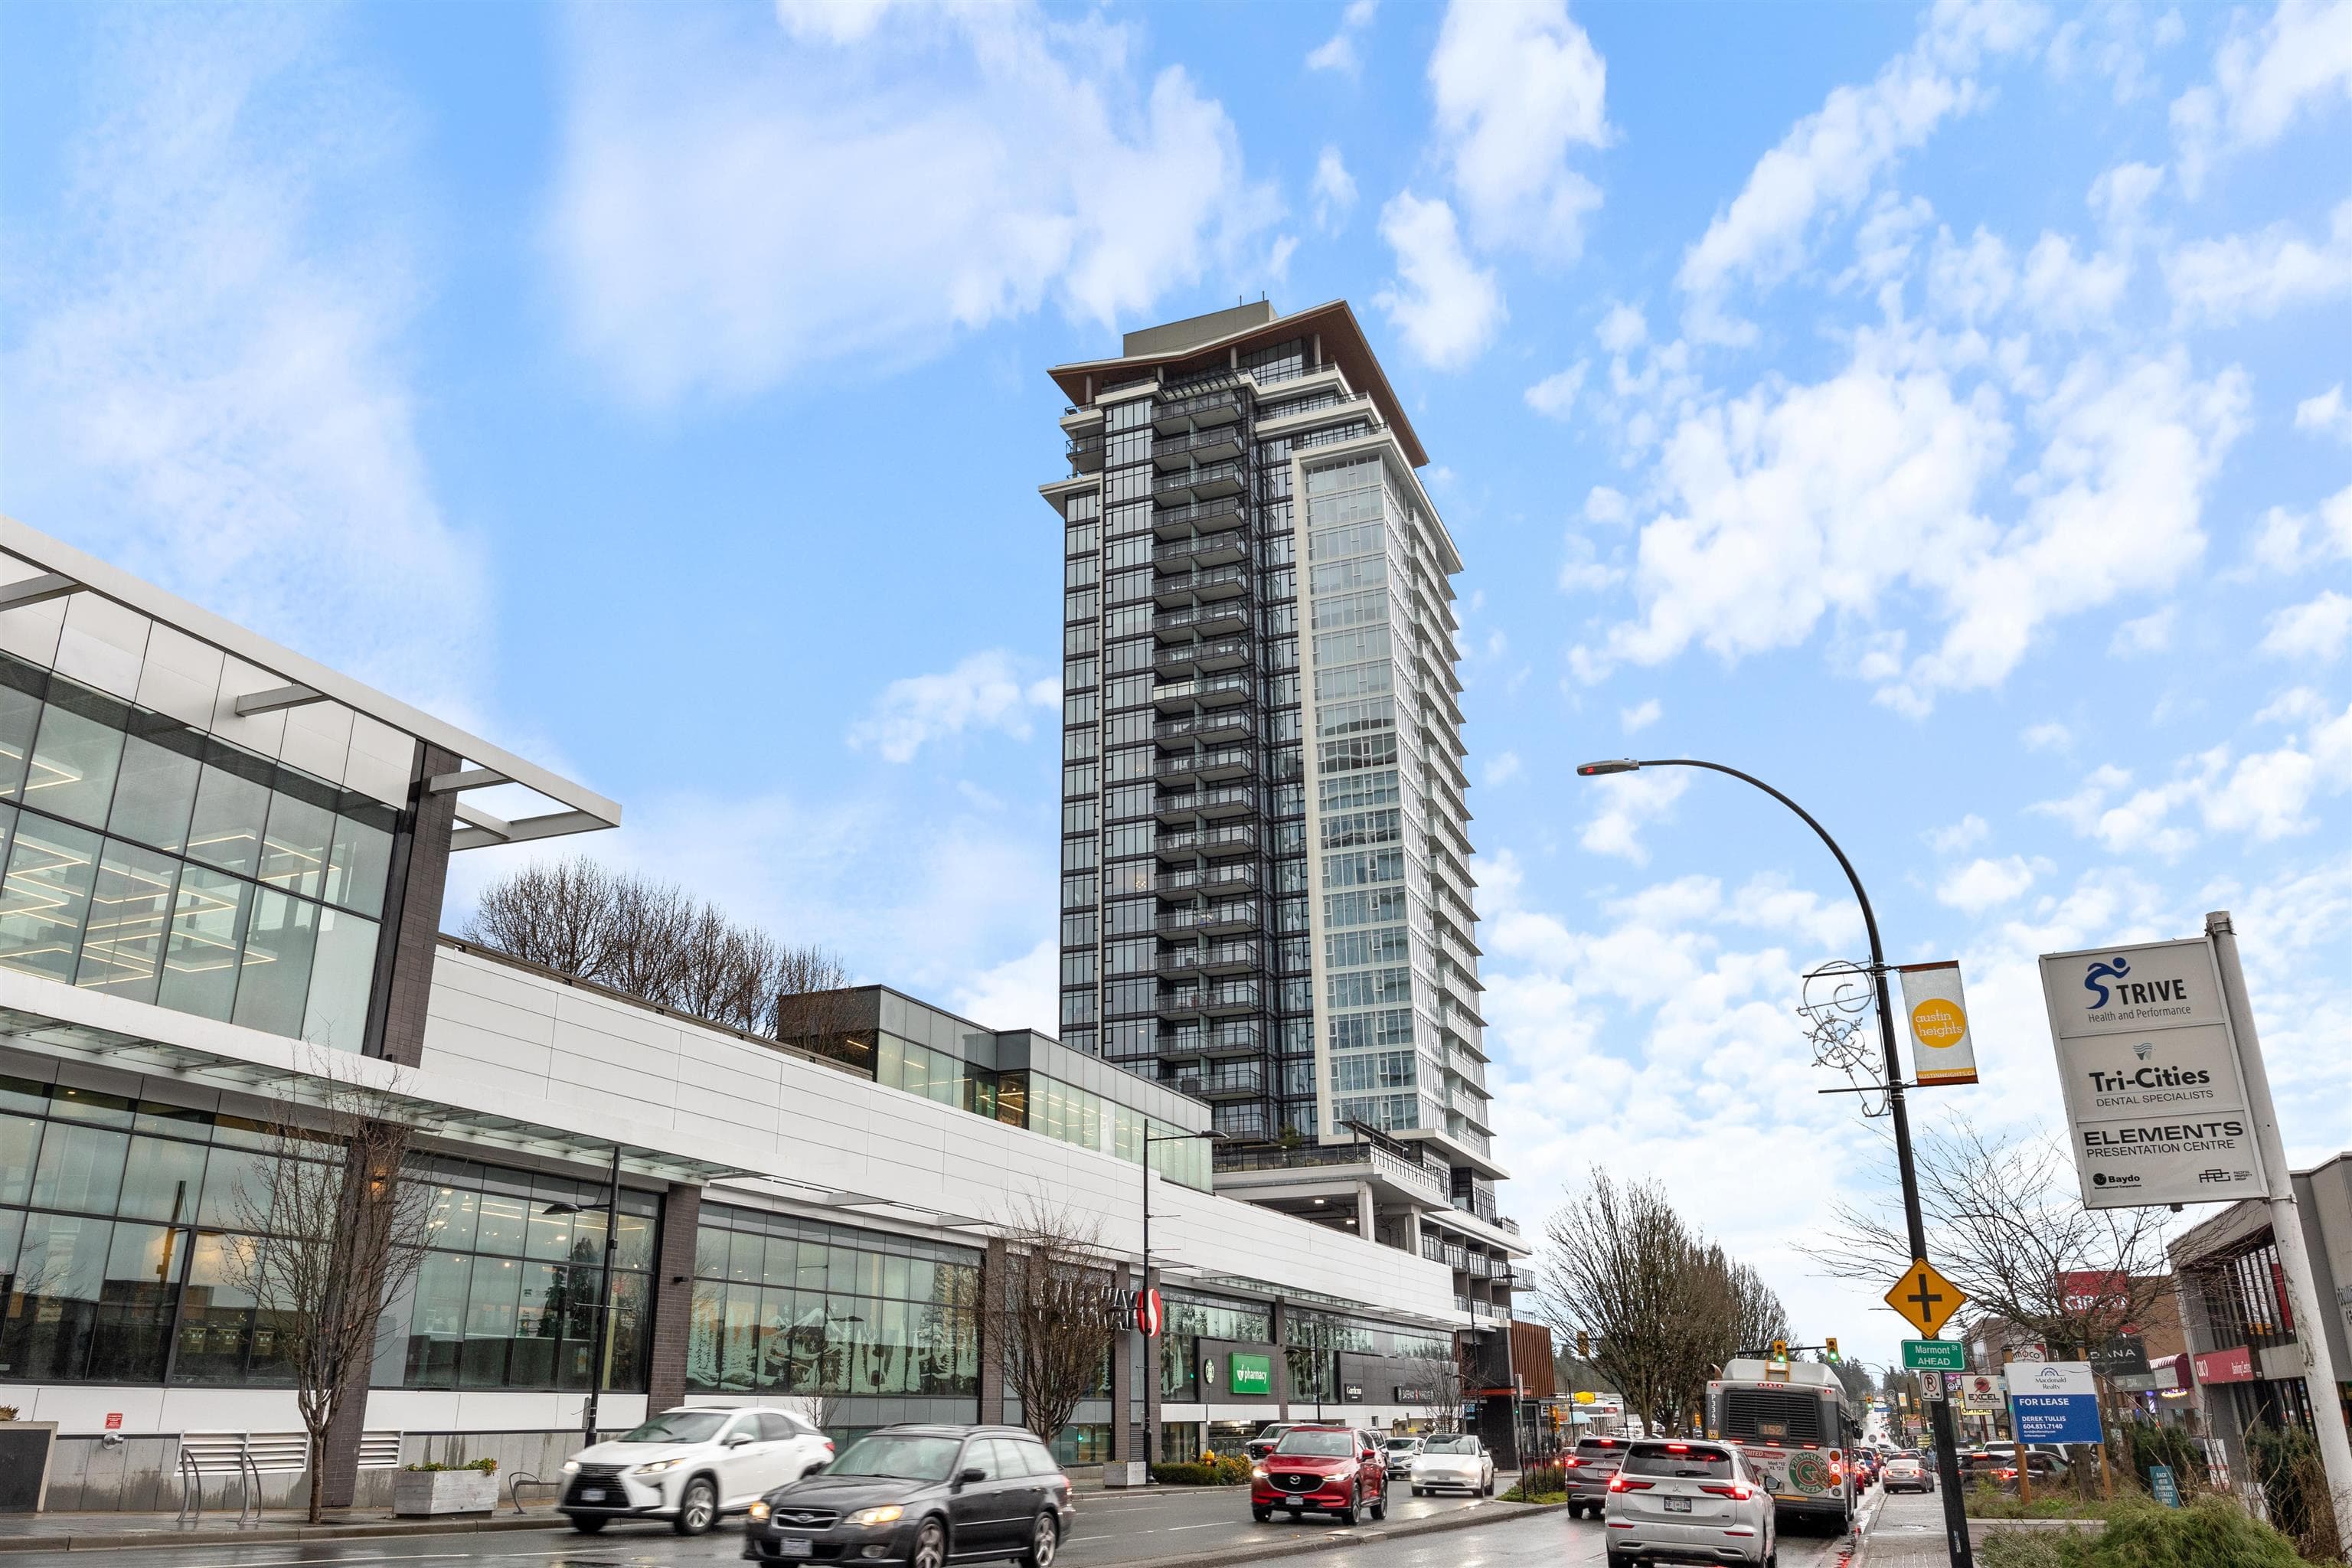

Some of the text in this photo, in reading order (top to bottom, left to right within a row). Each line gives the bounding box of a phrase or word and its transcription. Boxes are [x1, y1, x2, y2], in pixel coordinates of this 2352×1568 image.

[1916, 1009, 1952, 1023] austin
[2088, 1005, 2191, 1023] Health and Performance
[1918, 1021, 1963, 1037] heights
[2089, 1066, 2210, 1092] Tri-Cities
[2096, 1090, 2213, 1107] DENTAL SPECIALISTS
[2083, 1121, 2243, 1146] ELEMENTS
[2086, 1139, 2236, 1158] PRESENTATION CENTRE
[2108, 1174, 2141, 1184] Baydo
[1915, 1345, 1951, 1354] Marmont
[1244, 1367, 1267, 1384] pharmacy
[1968, 1393, 2000, 1403] EXCEL
[1791, 1452, 1828, 1471] FRESHSLICE
[1798, 1484, 1821, 1493] PIZZA
